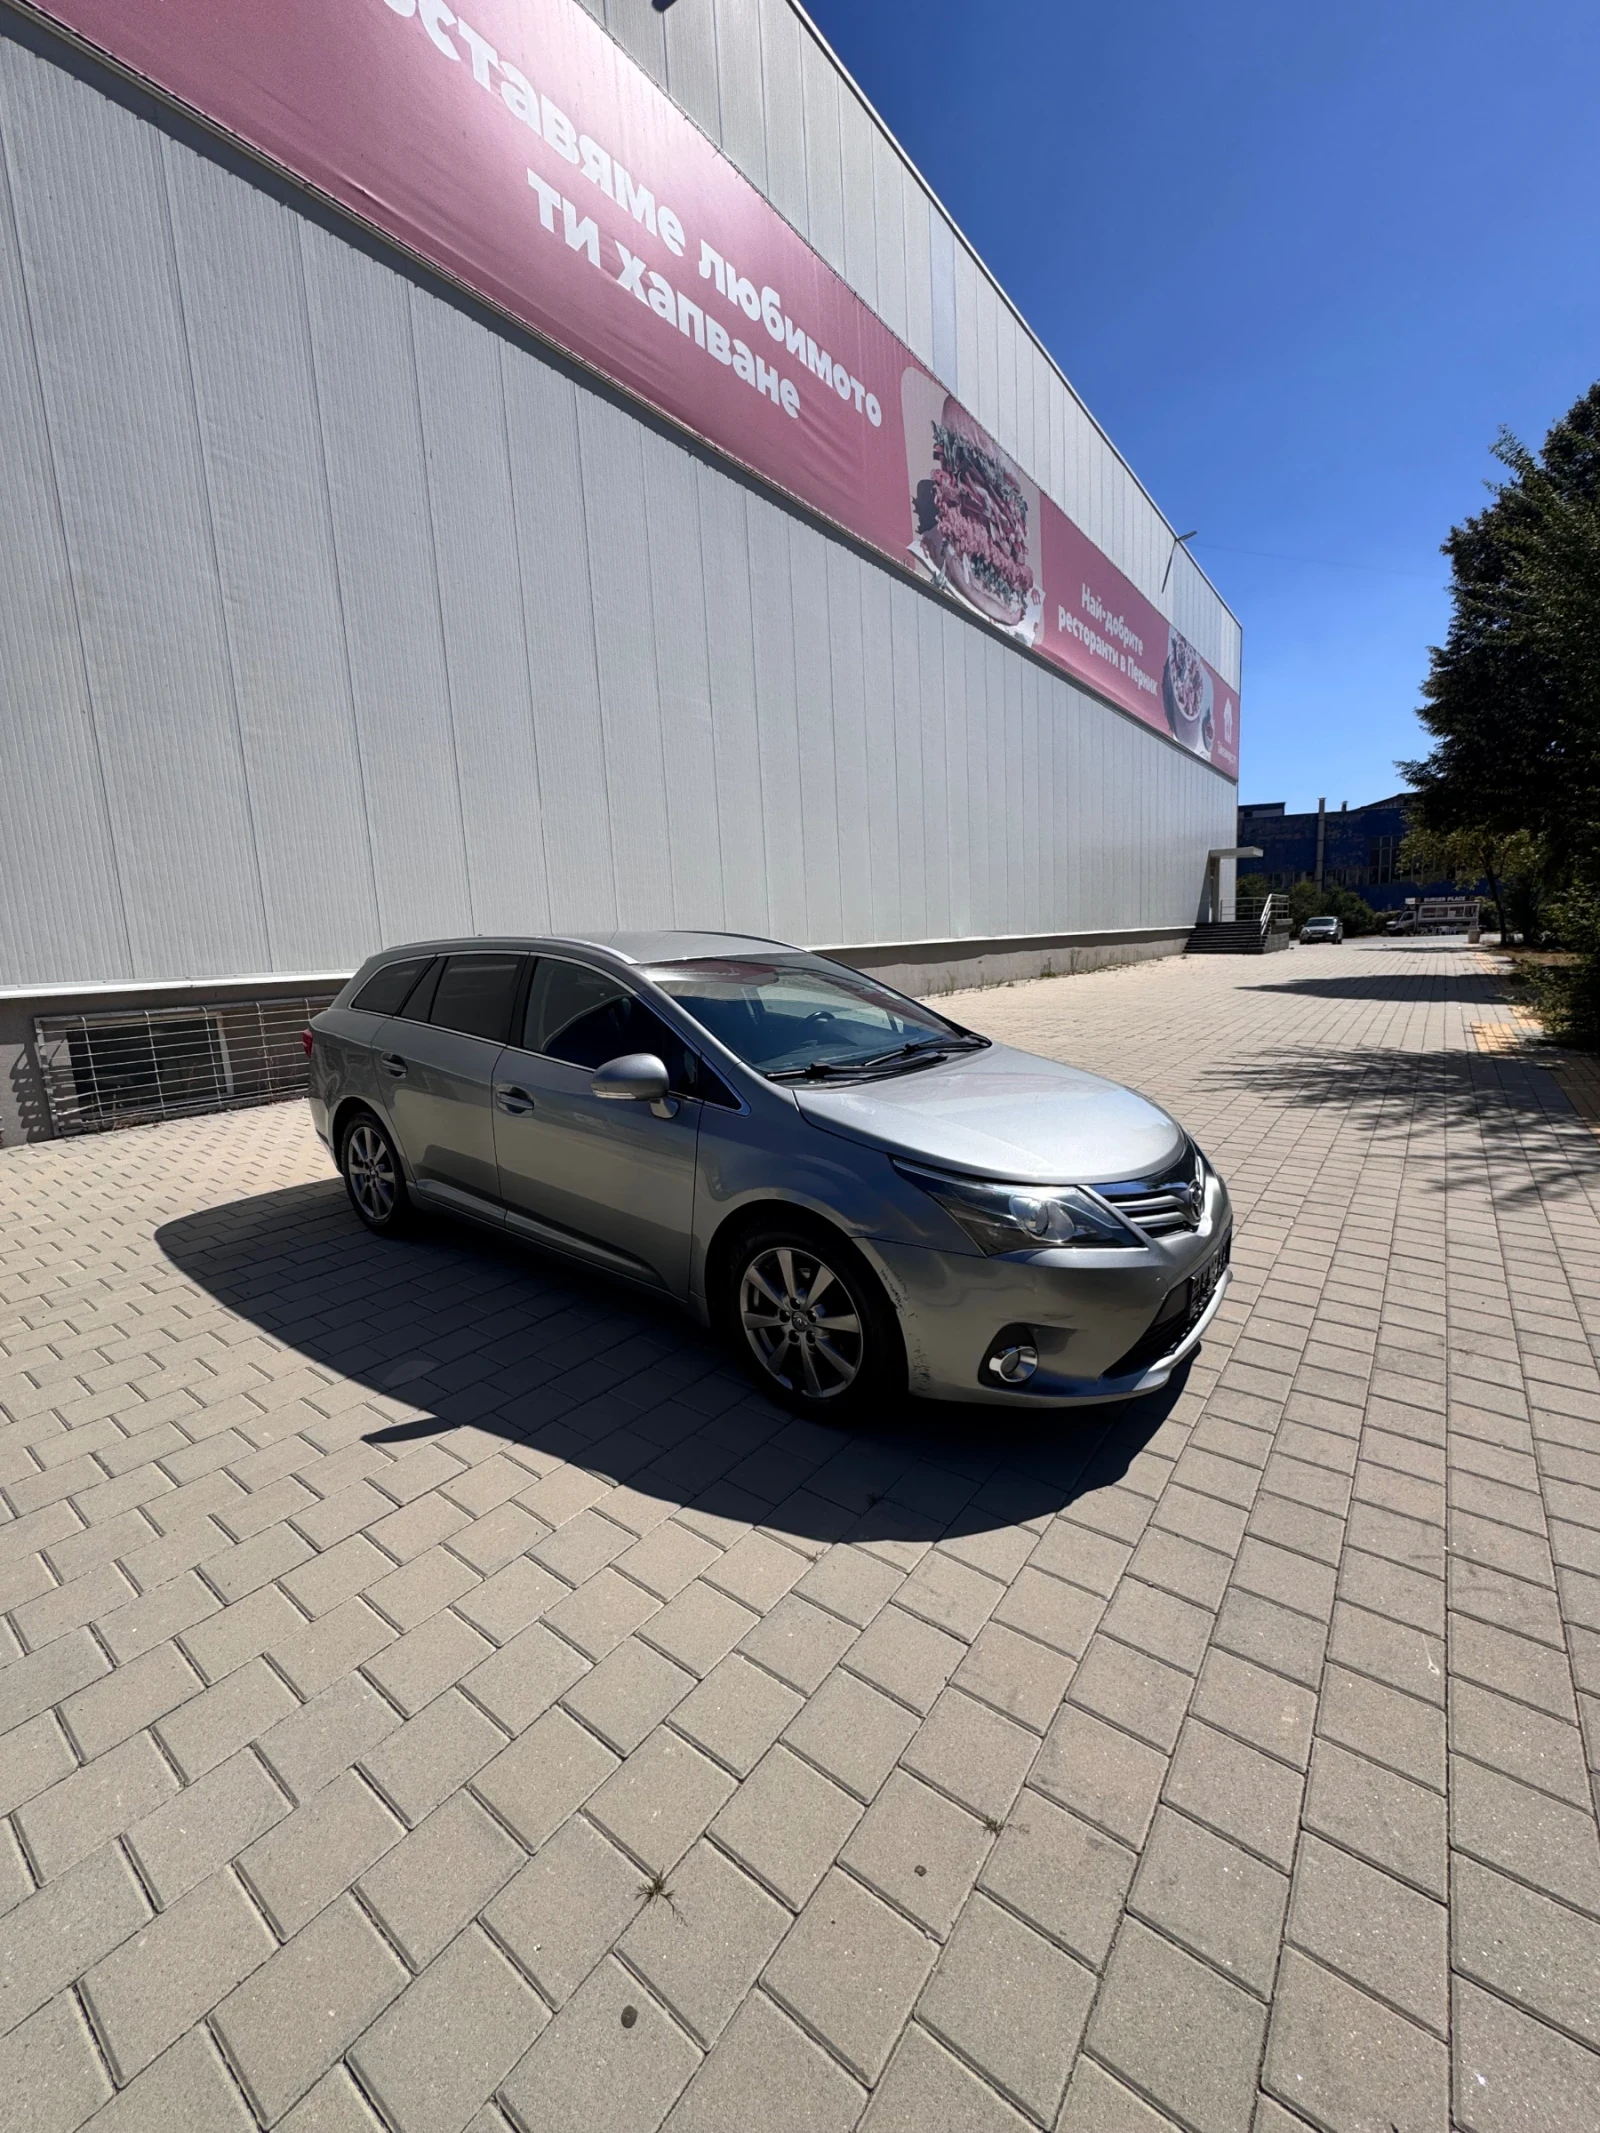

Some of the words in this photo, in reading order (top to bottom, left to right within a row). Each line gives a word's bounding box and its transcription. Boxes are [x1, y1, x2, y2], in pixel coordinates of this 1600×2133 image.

[384, 0, 686, 257] ставяме
[699, 239, 882, 428] любимото
[526, 167, 602, 269] ти
[615, 240, 800, 419] хапване
[1058, 604, 1119, 668] ресторанти
[1120, 654, 1127, 673] в
[1127, 655, 1158, 697] Перник
[1081, 583, 1144, 657] Най-добрите
